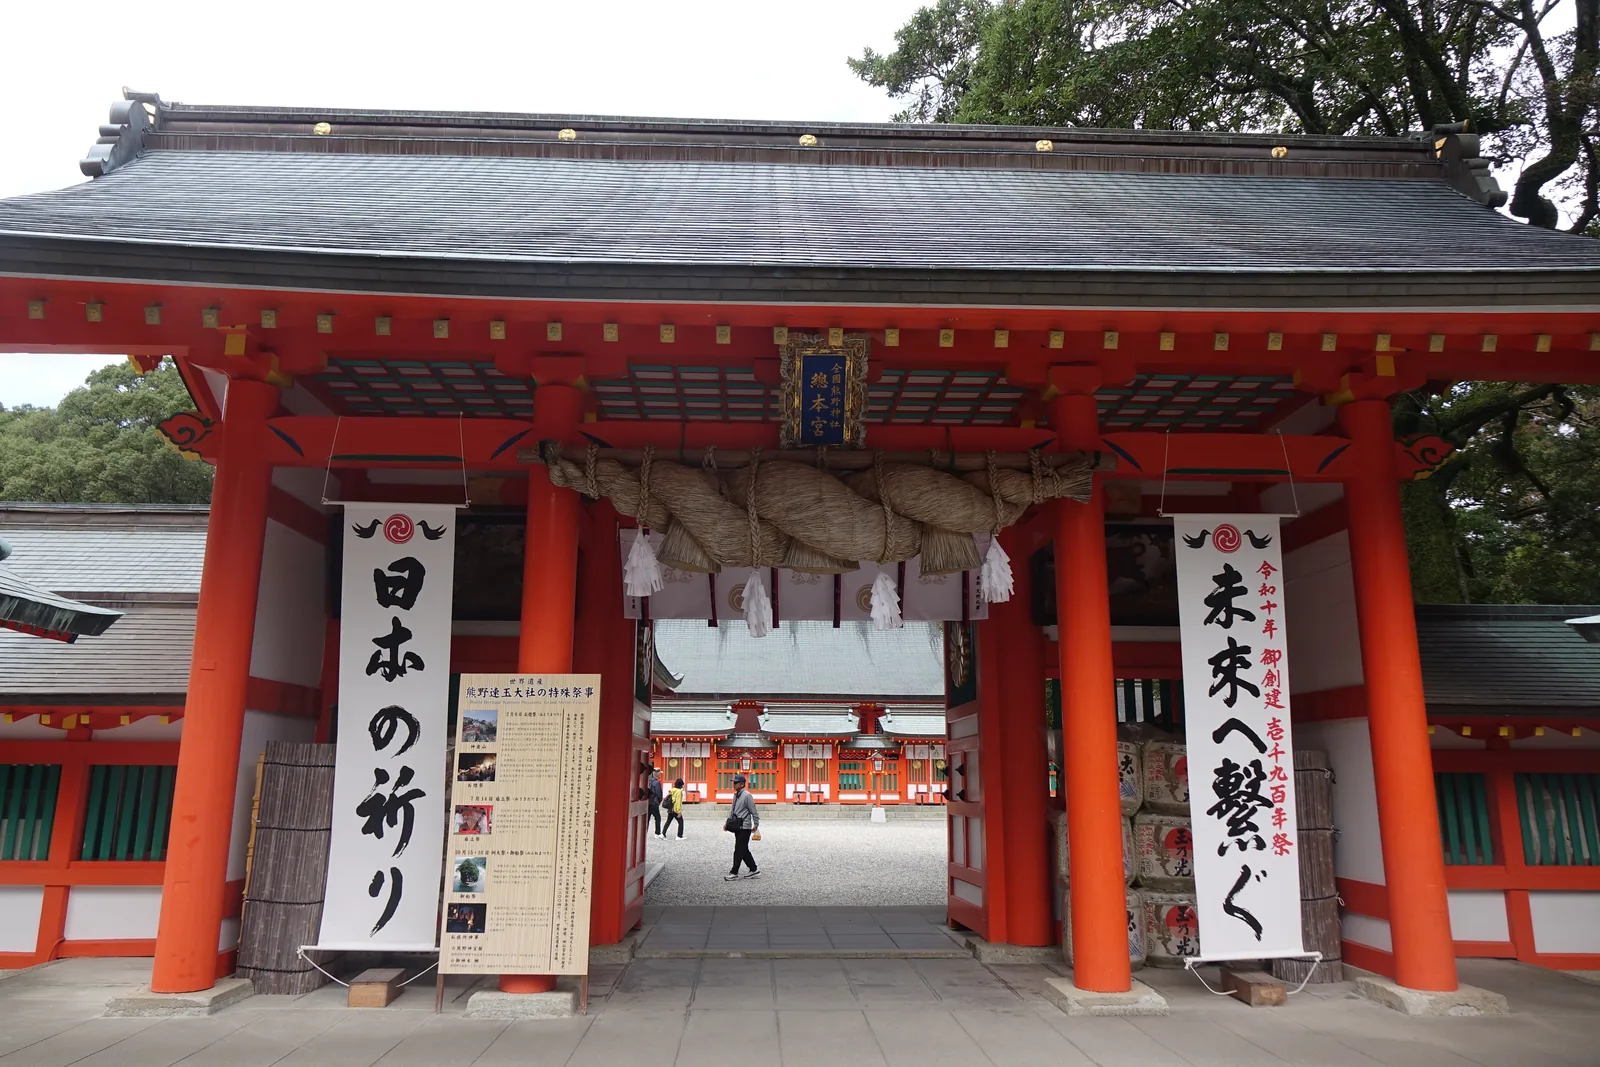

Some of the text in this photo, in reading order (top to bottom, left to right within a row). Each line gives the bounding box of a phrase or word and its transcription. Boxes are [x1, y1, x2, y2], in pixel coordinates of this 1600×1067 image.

[1256, 561, 1278, 640] 令和十年
[466, 686, 594, 699] 熊野速玉大社の特殊祭事
[509, 677, 543, 685] 世界遺産
[1260, 648, 1284, 710] 御創建
[356, 557, 426, 937] 日本の祈り
